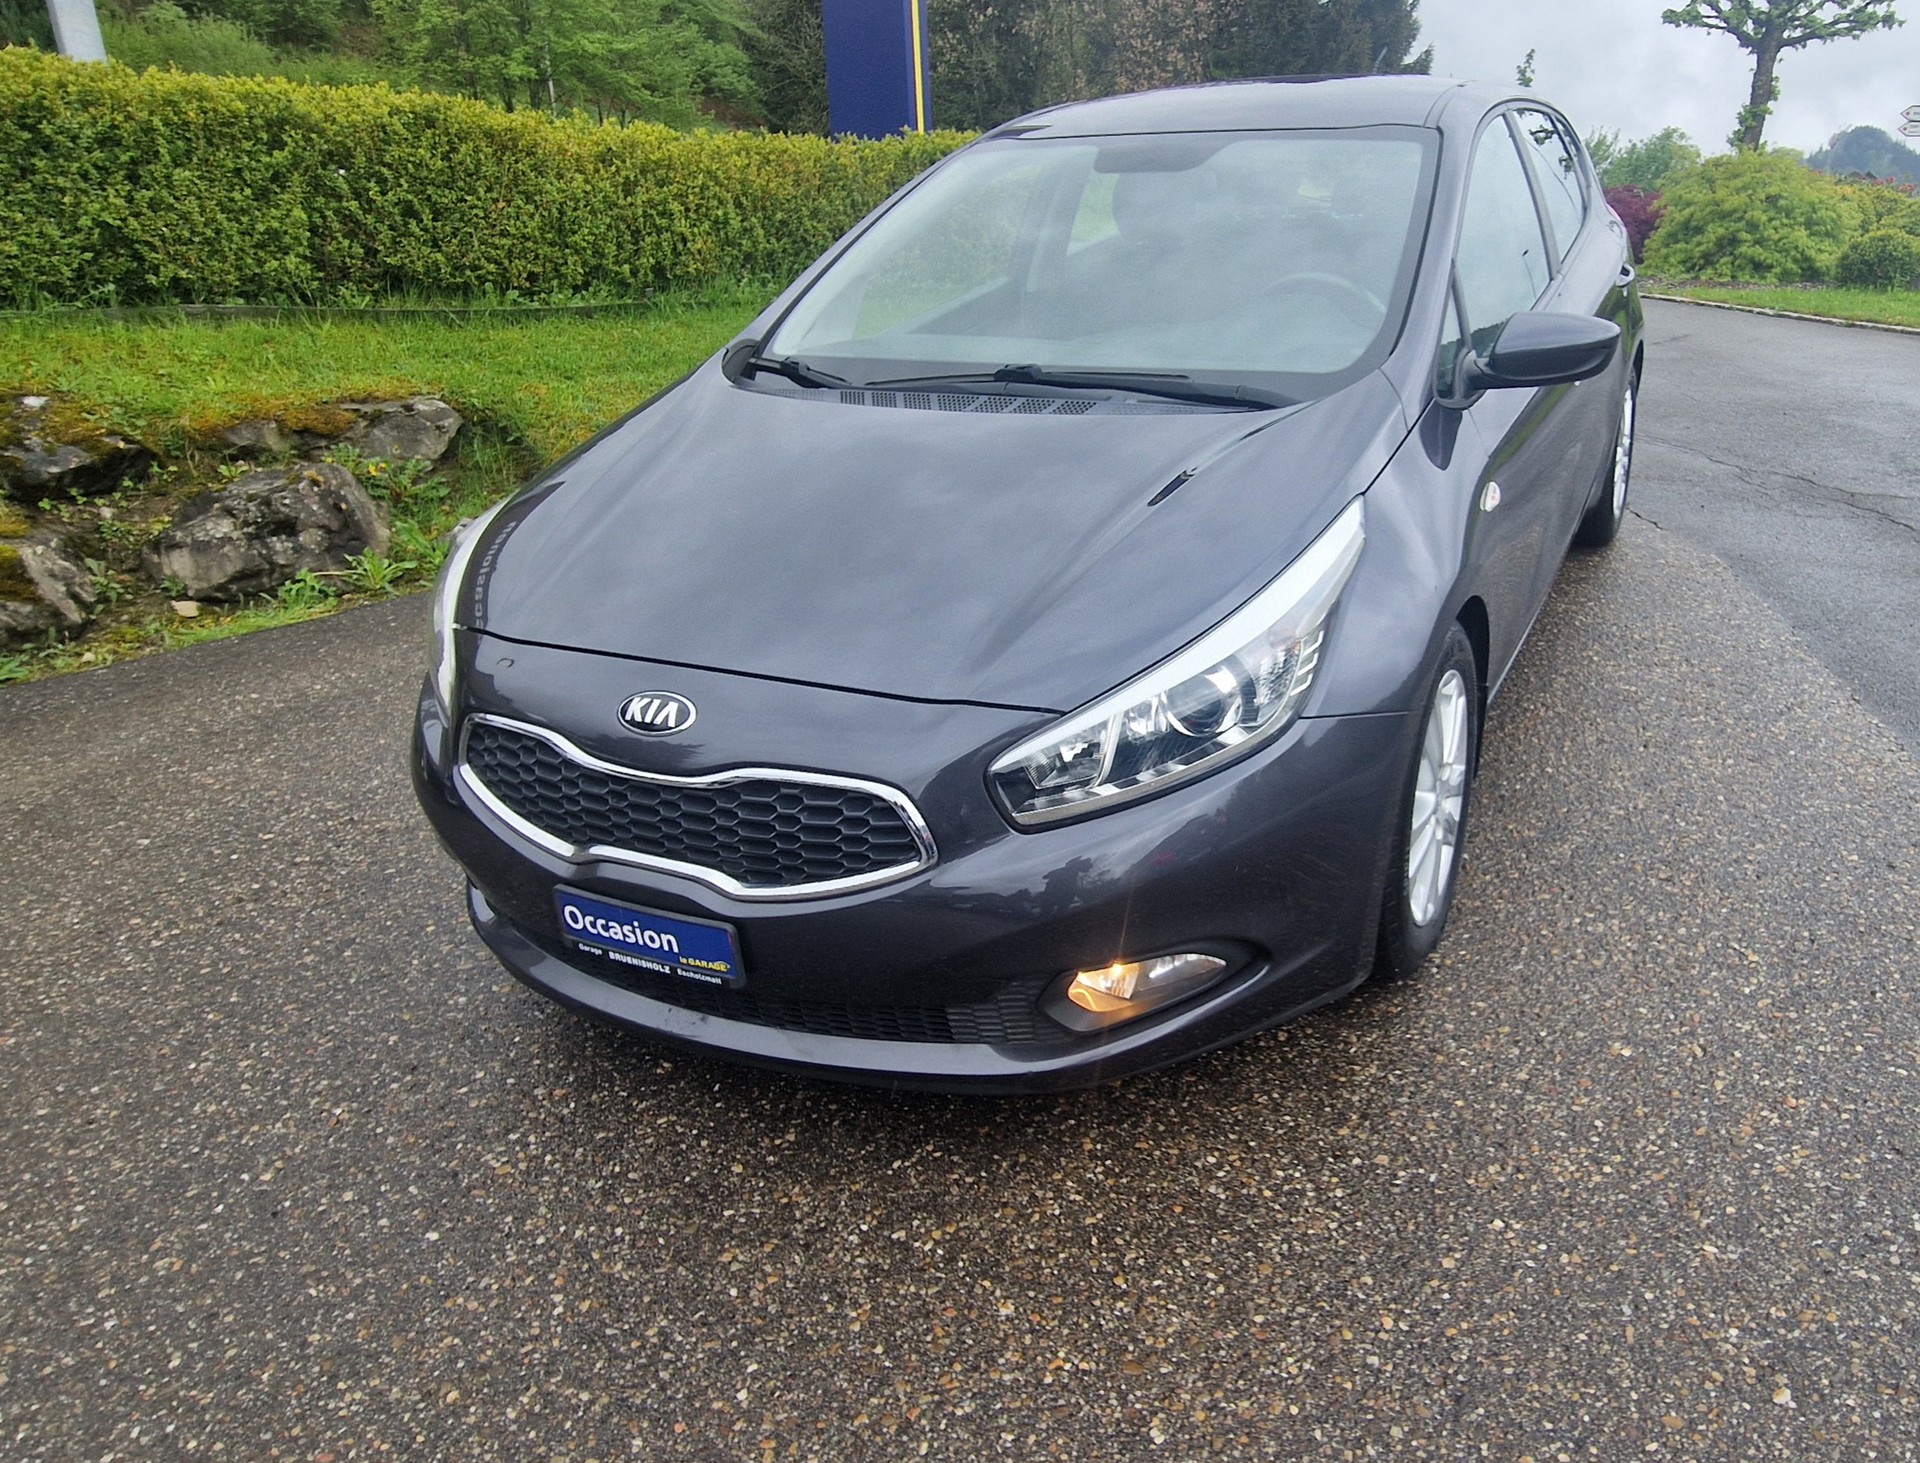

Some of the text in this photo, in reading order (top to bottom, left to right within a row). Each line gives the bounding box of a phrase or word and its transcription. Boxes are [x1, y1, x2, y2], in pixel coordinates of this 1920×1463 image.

[624, 697, 679, 728] KIA
[563, 904, 679, 953] Occasion
[578, 942, 603, 956] Garage
[688, 957, 729, 973] GARAGE
